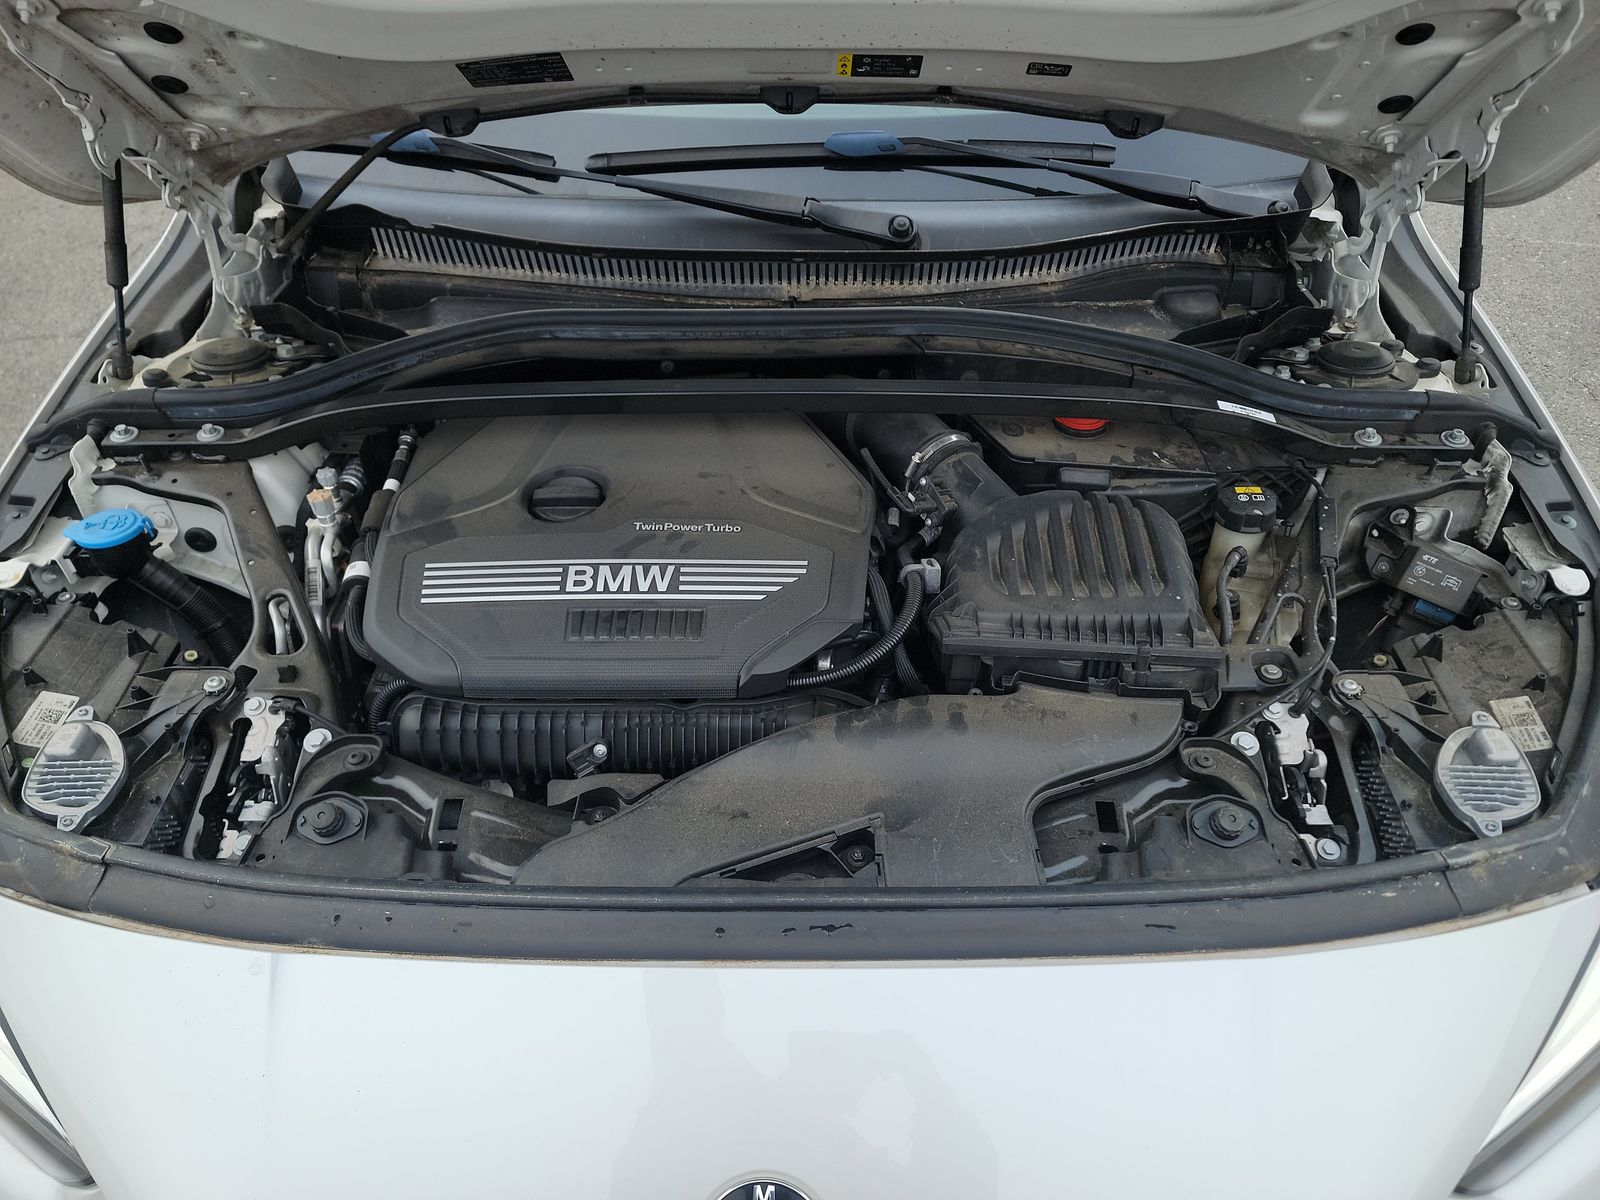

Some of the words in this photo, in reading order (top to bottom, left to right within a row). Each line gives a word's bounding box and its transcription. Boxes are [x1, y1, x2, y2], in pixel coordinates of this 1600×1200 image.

[633, 522, 704, 533] TwinPower
[705, 523, 742, 533] Turbo
[565, 564, 676, 592] BMW
[752, 1184, 776, 1200] M
